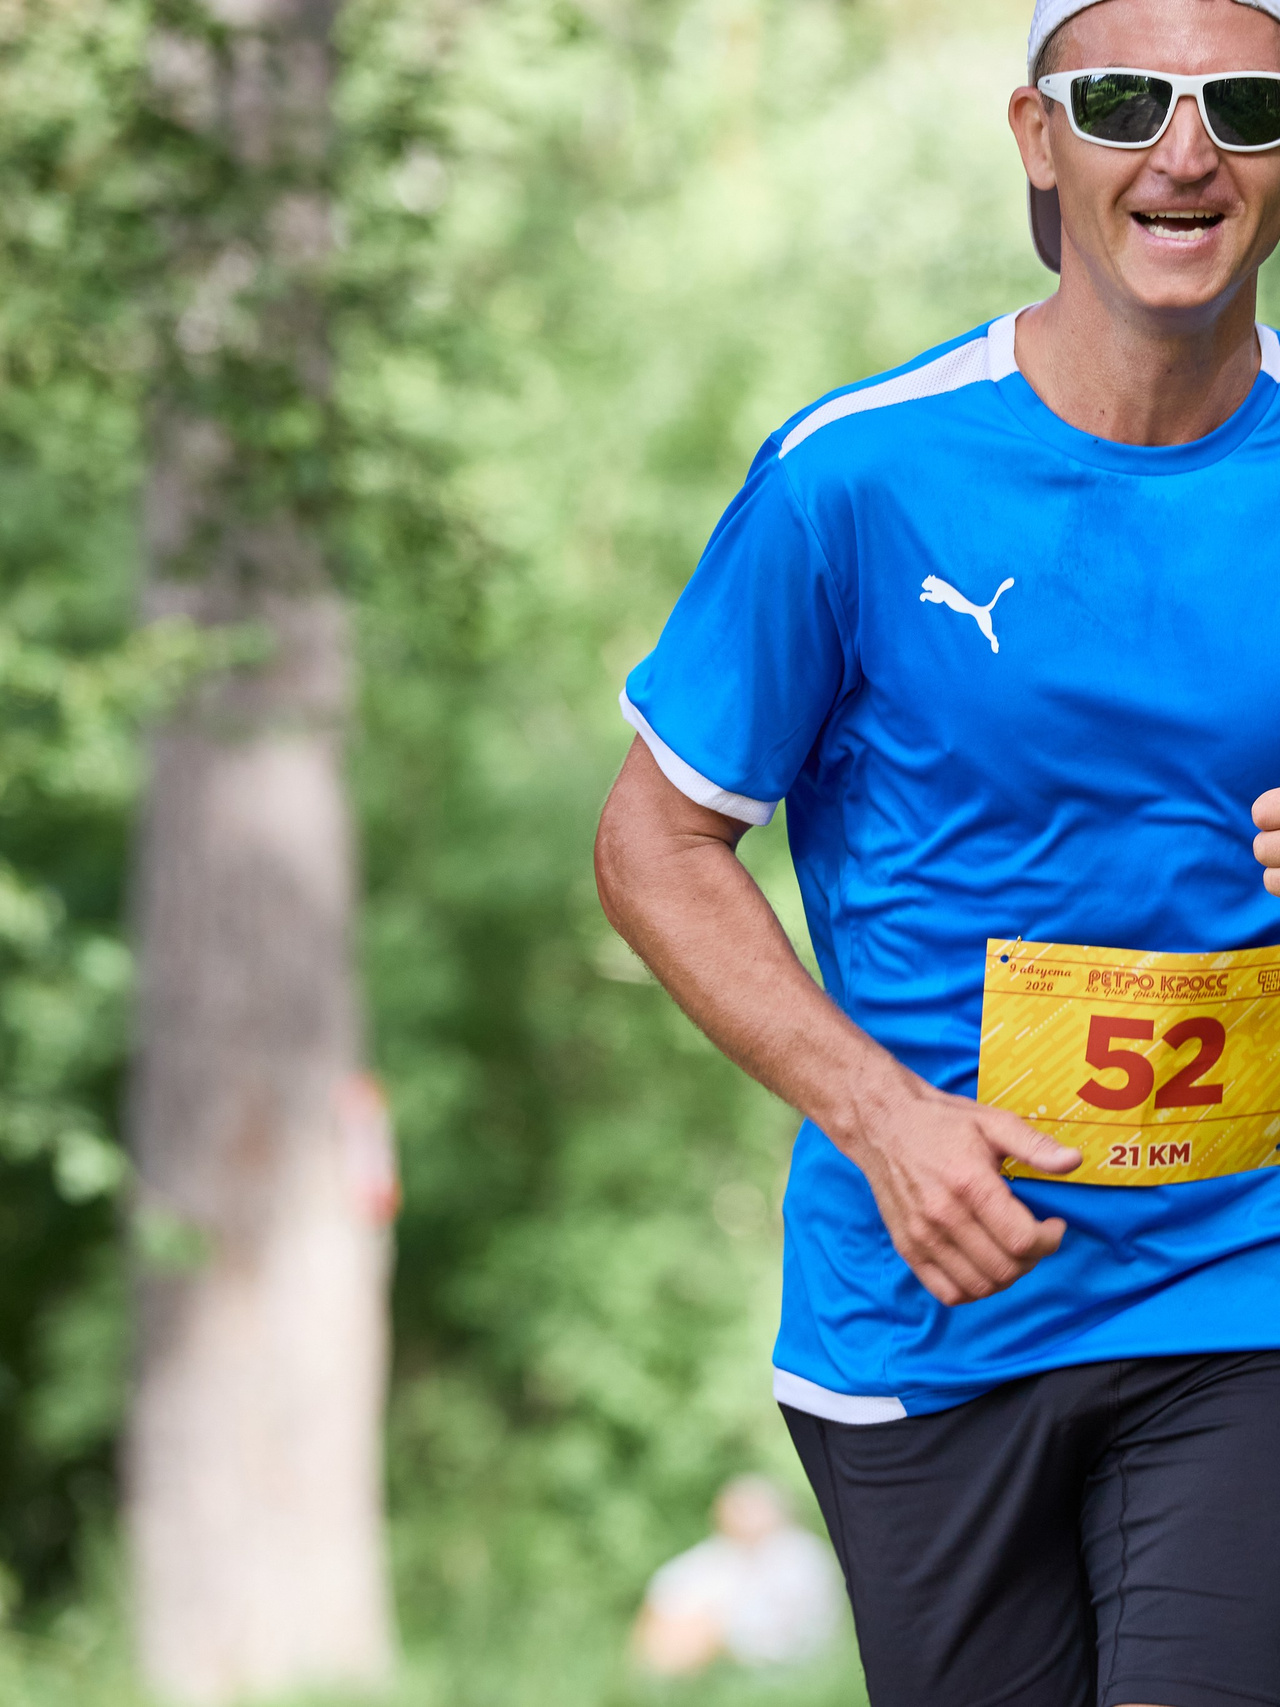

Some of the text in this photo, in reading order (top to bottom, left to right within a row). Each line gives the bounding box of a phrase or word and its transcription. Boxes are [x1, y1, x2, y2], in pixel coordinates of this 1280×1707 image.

[1010, 963, 1072, 979] 9 августа
[1025, 980, 1054, 992] 2026
[1088, 969, 1229, 993] РЕТРО КРОСС
[1103, 986, 1128, 997] дню
[1132, 988, 1227, 1003] физкультурника
[1076, 1014, 1226, 1111] 52
[1109, 1145, 1140, 1167] 21
